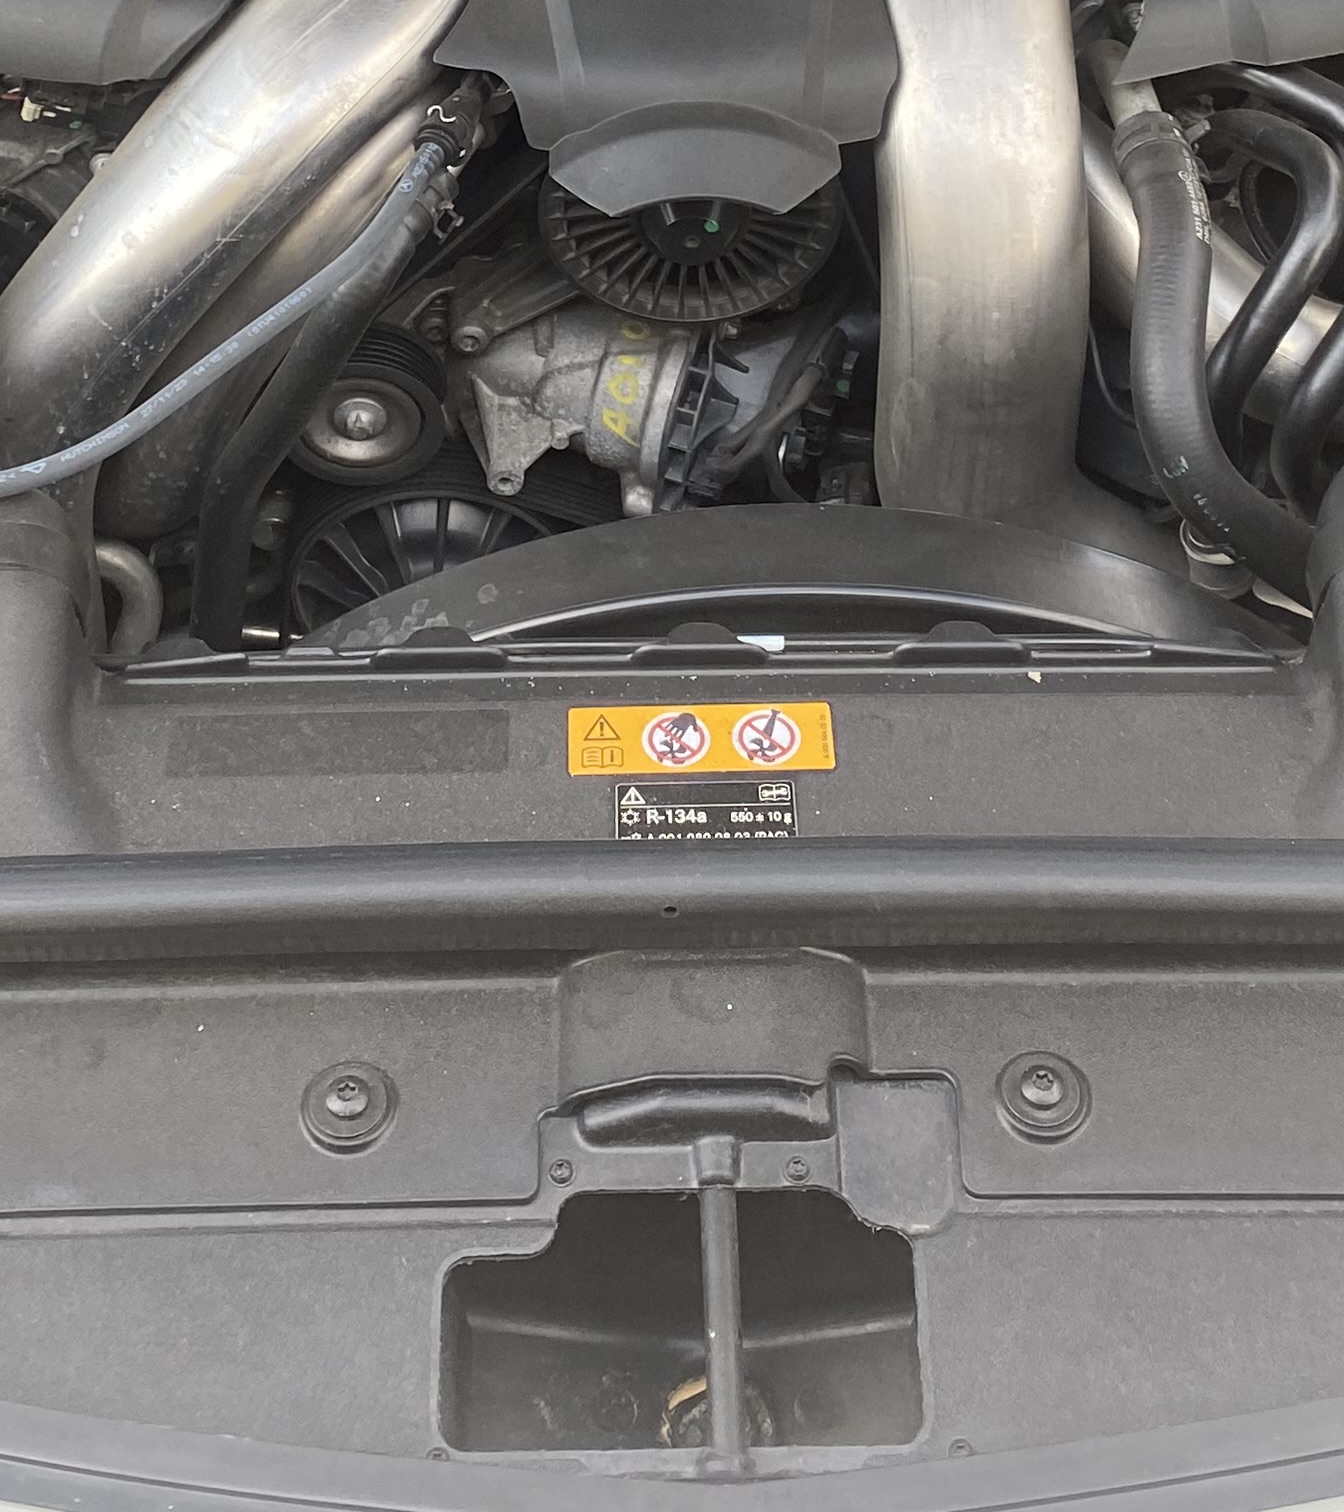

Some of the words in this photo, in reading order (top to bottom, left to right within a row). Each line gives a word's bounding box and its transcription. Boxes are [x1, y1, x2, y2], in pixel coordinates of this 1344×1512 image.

[60, 422, 130, 462] HUTCHINSON
[140, 379, 188, 418] 27/11/23
[646, 808, 707, 825] R-134a
[730, 811, 754, 823] 550
[767, 811, 783, 822] 10
[784, 812, 793, 825] g
